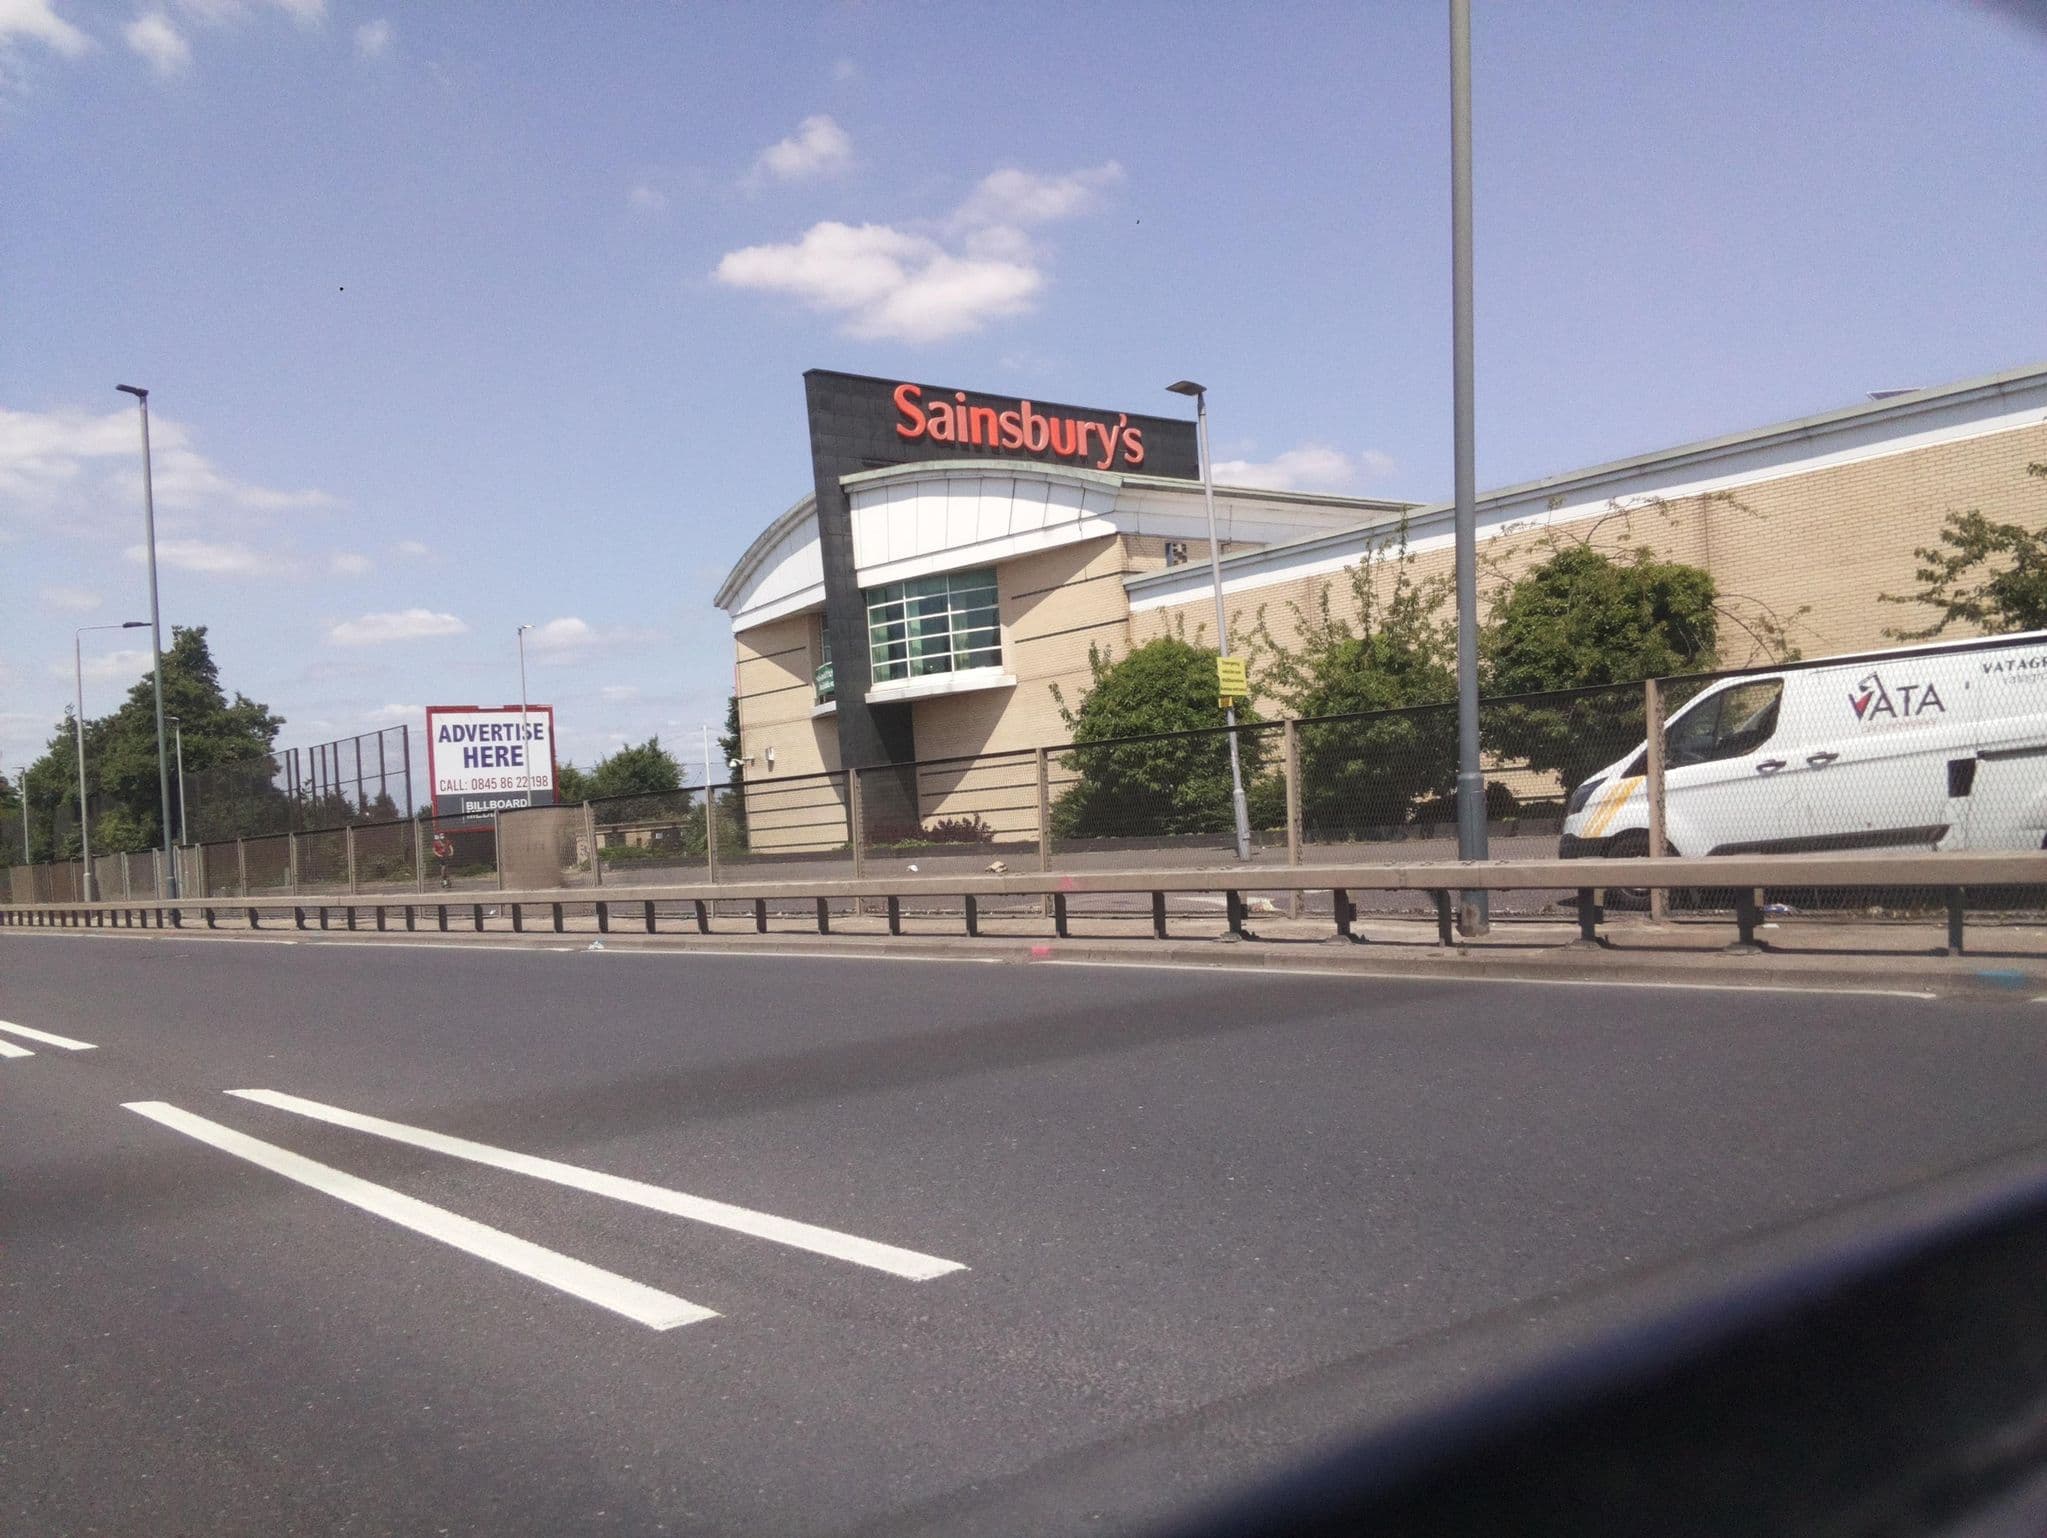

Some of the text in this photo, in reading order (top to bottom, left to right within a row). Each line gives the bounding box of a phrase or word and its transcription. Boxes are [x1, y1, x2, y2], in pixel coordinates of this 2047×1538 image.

[893, 384, 1145, 470] Sainsbury's
[1848, 672, 1946, 720] VATA
[438, 723, 545, 743] ADVERTISE
[463, 745, 524, 768] HERE
[440, 779, 468, 792] CALL:
[471, 778, 497, 791] 0845
[500, 777, 513, 789] 86
[465, 799, 528, 811] BILLBOARD
